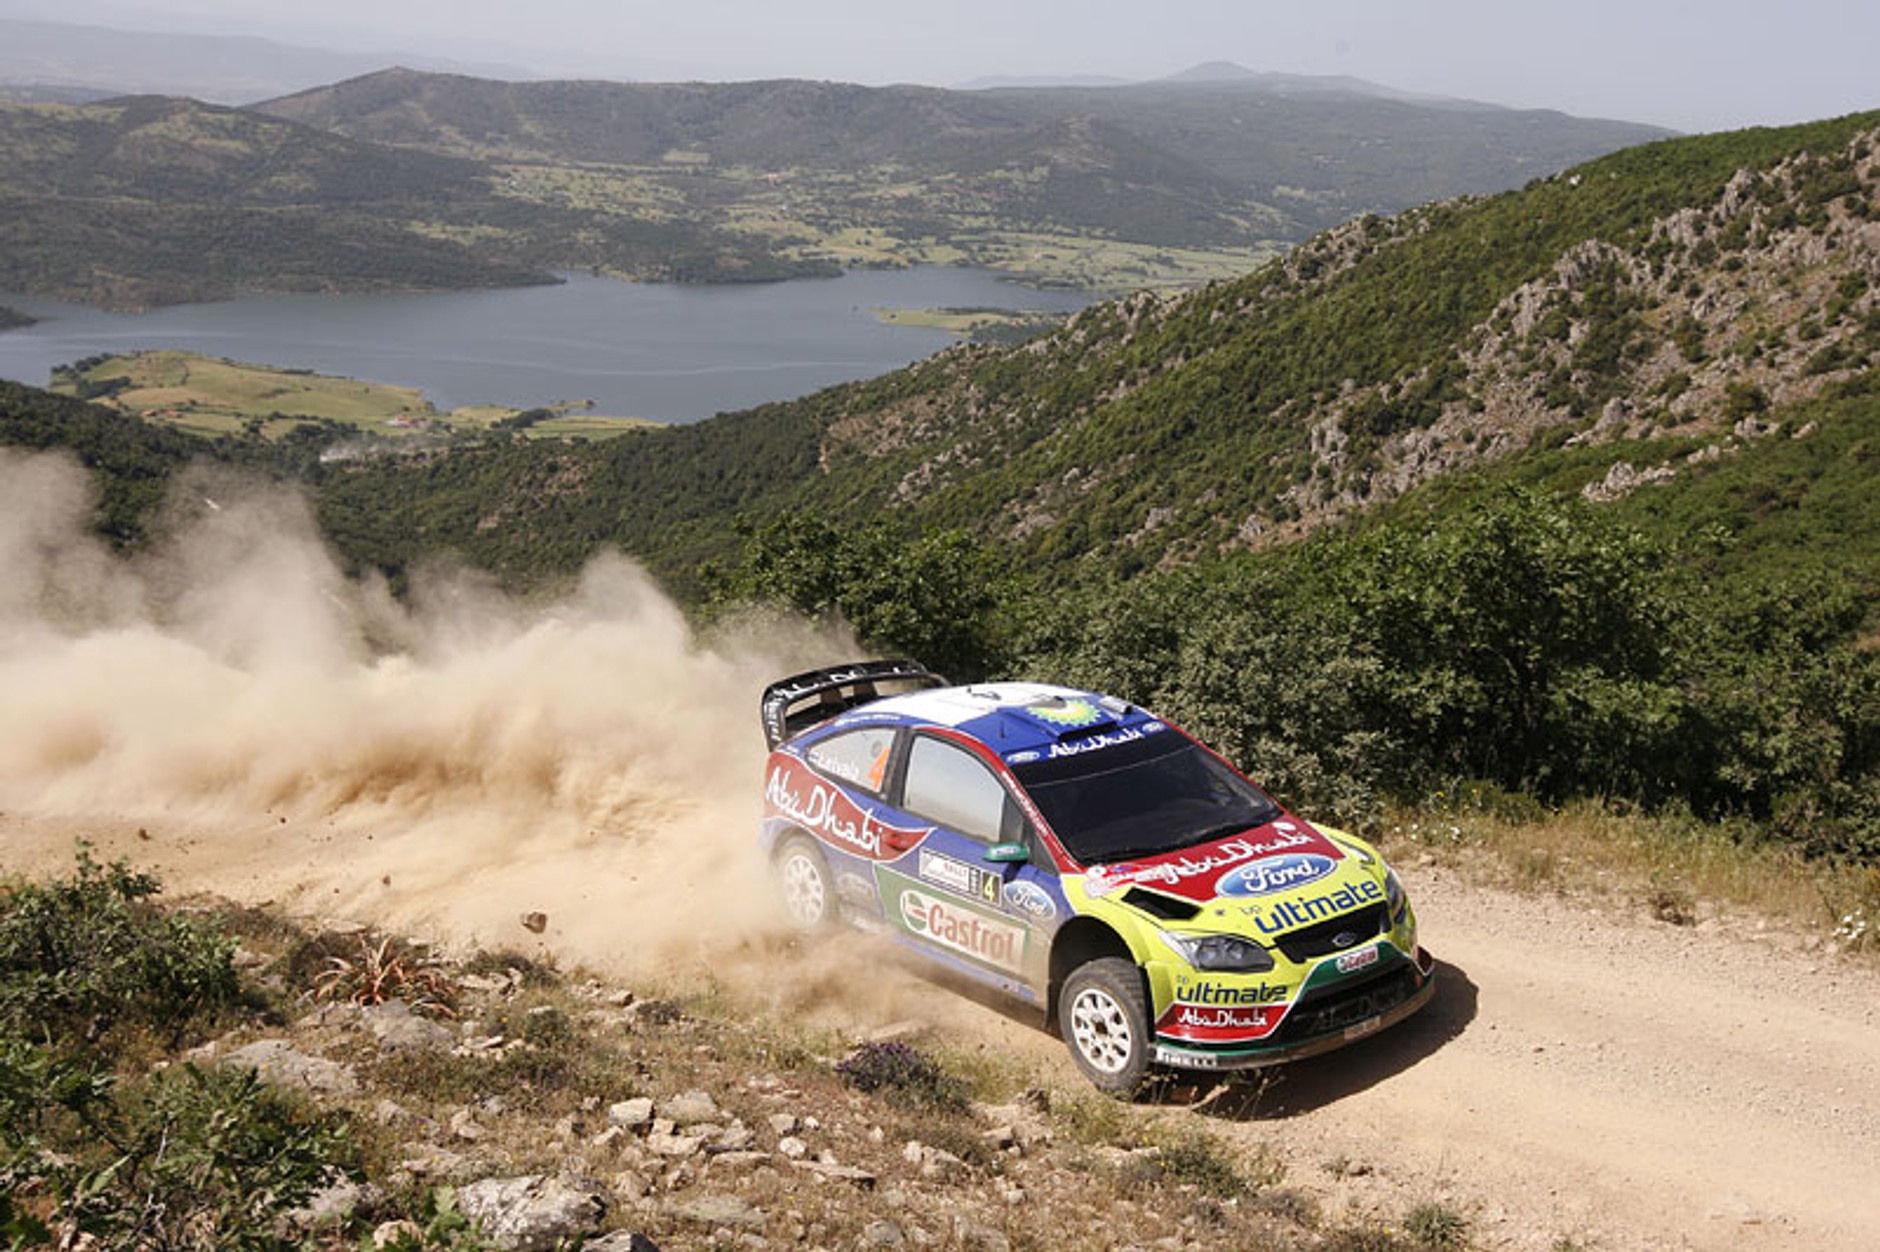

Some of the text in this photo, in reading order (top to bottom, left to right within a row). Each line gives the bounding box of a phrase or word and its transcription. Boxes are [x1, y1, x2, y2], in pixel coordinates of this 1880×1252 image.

[984, 875, 997, 901] 4
[1244, 857, 1321, 892] Ford
[1254, 879, 1382, 934] ultimate
[928, 903, 1016, 963] Castrol
[1176, 982, 1288, 1004] ultimate
